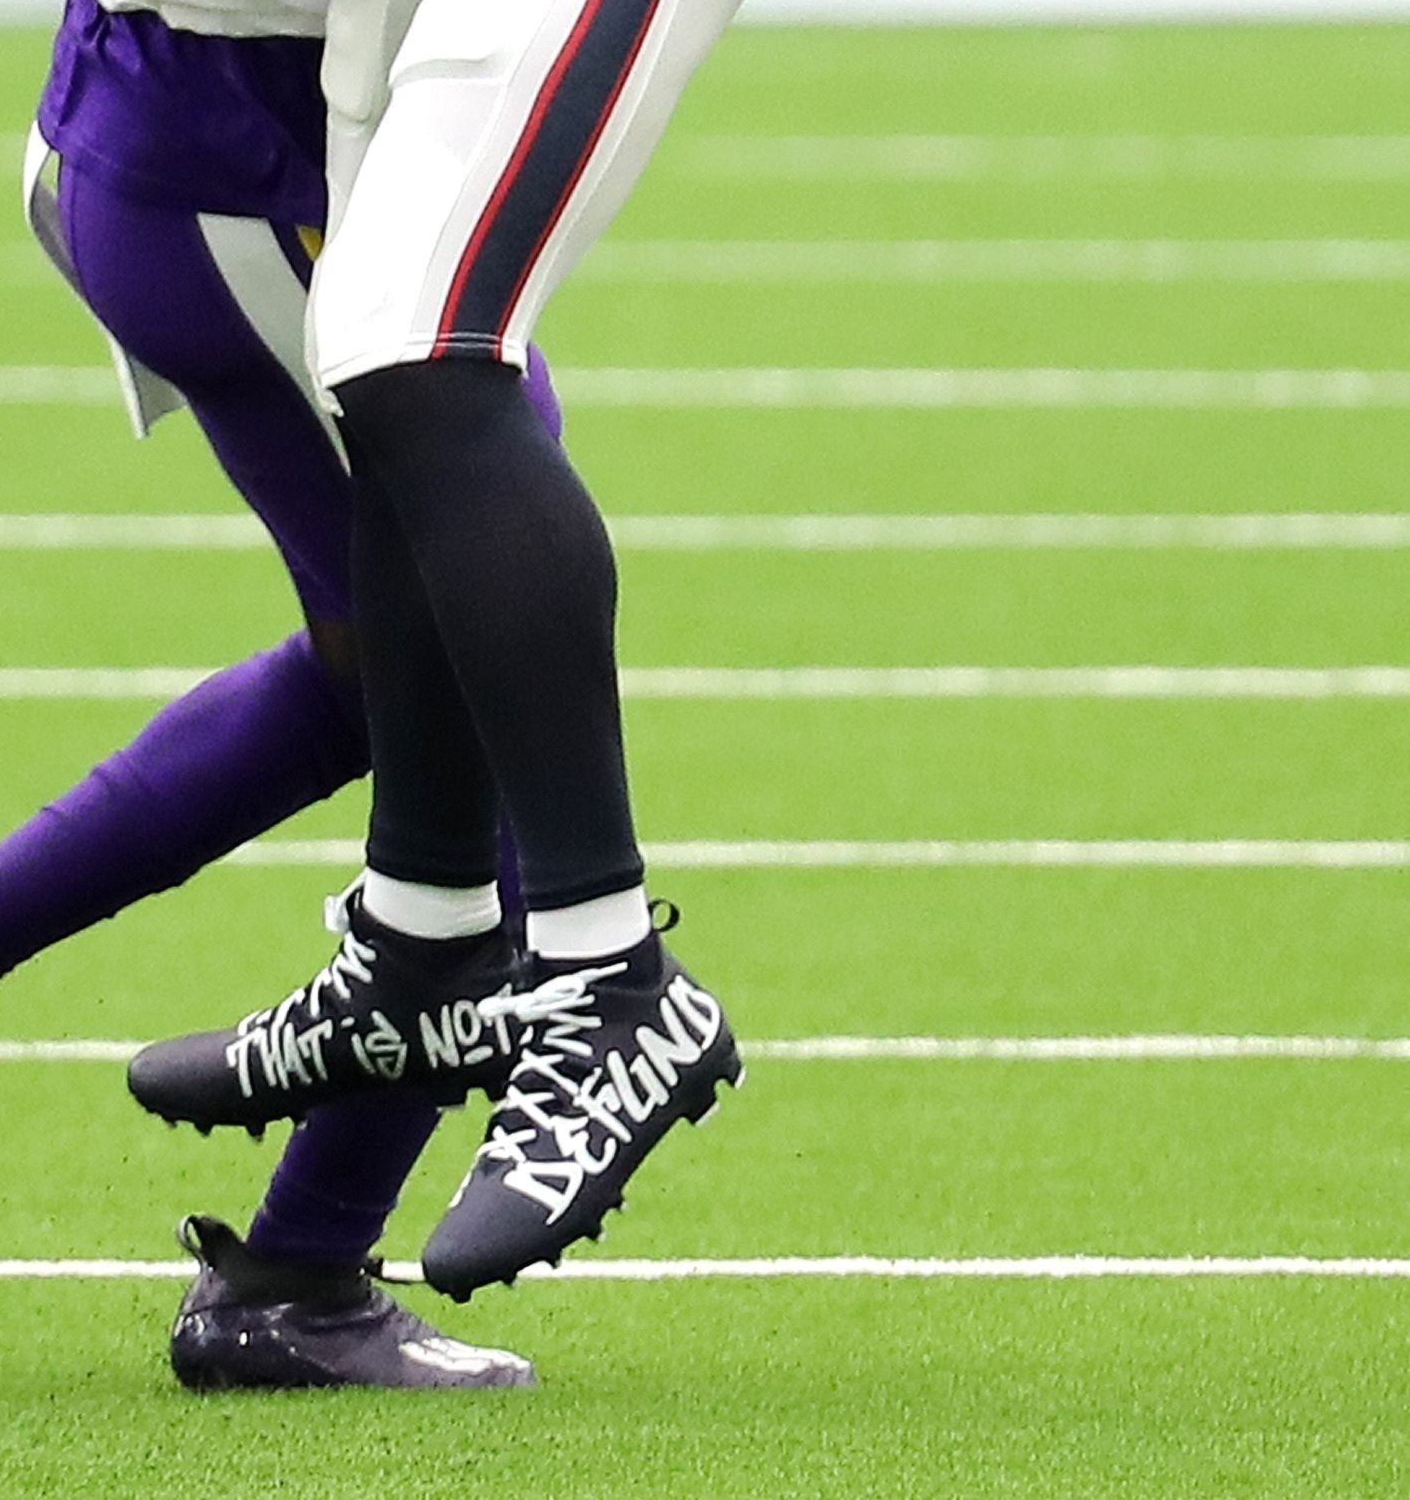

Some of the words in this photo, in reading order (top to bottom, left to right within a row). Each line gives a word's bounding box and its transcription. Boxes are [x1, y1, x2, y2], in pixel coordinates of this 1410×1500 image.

[225, 1017, 334, 1098] THAT
[418, 982, 513, 1070] NOT
[503, 974, 721, 1226] DEFUND
